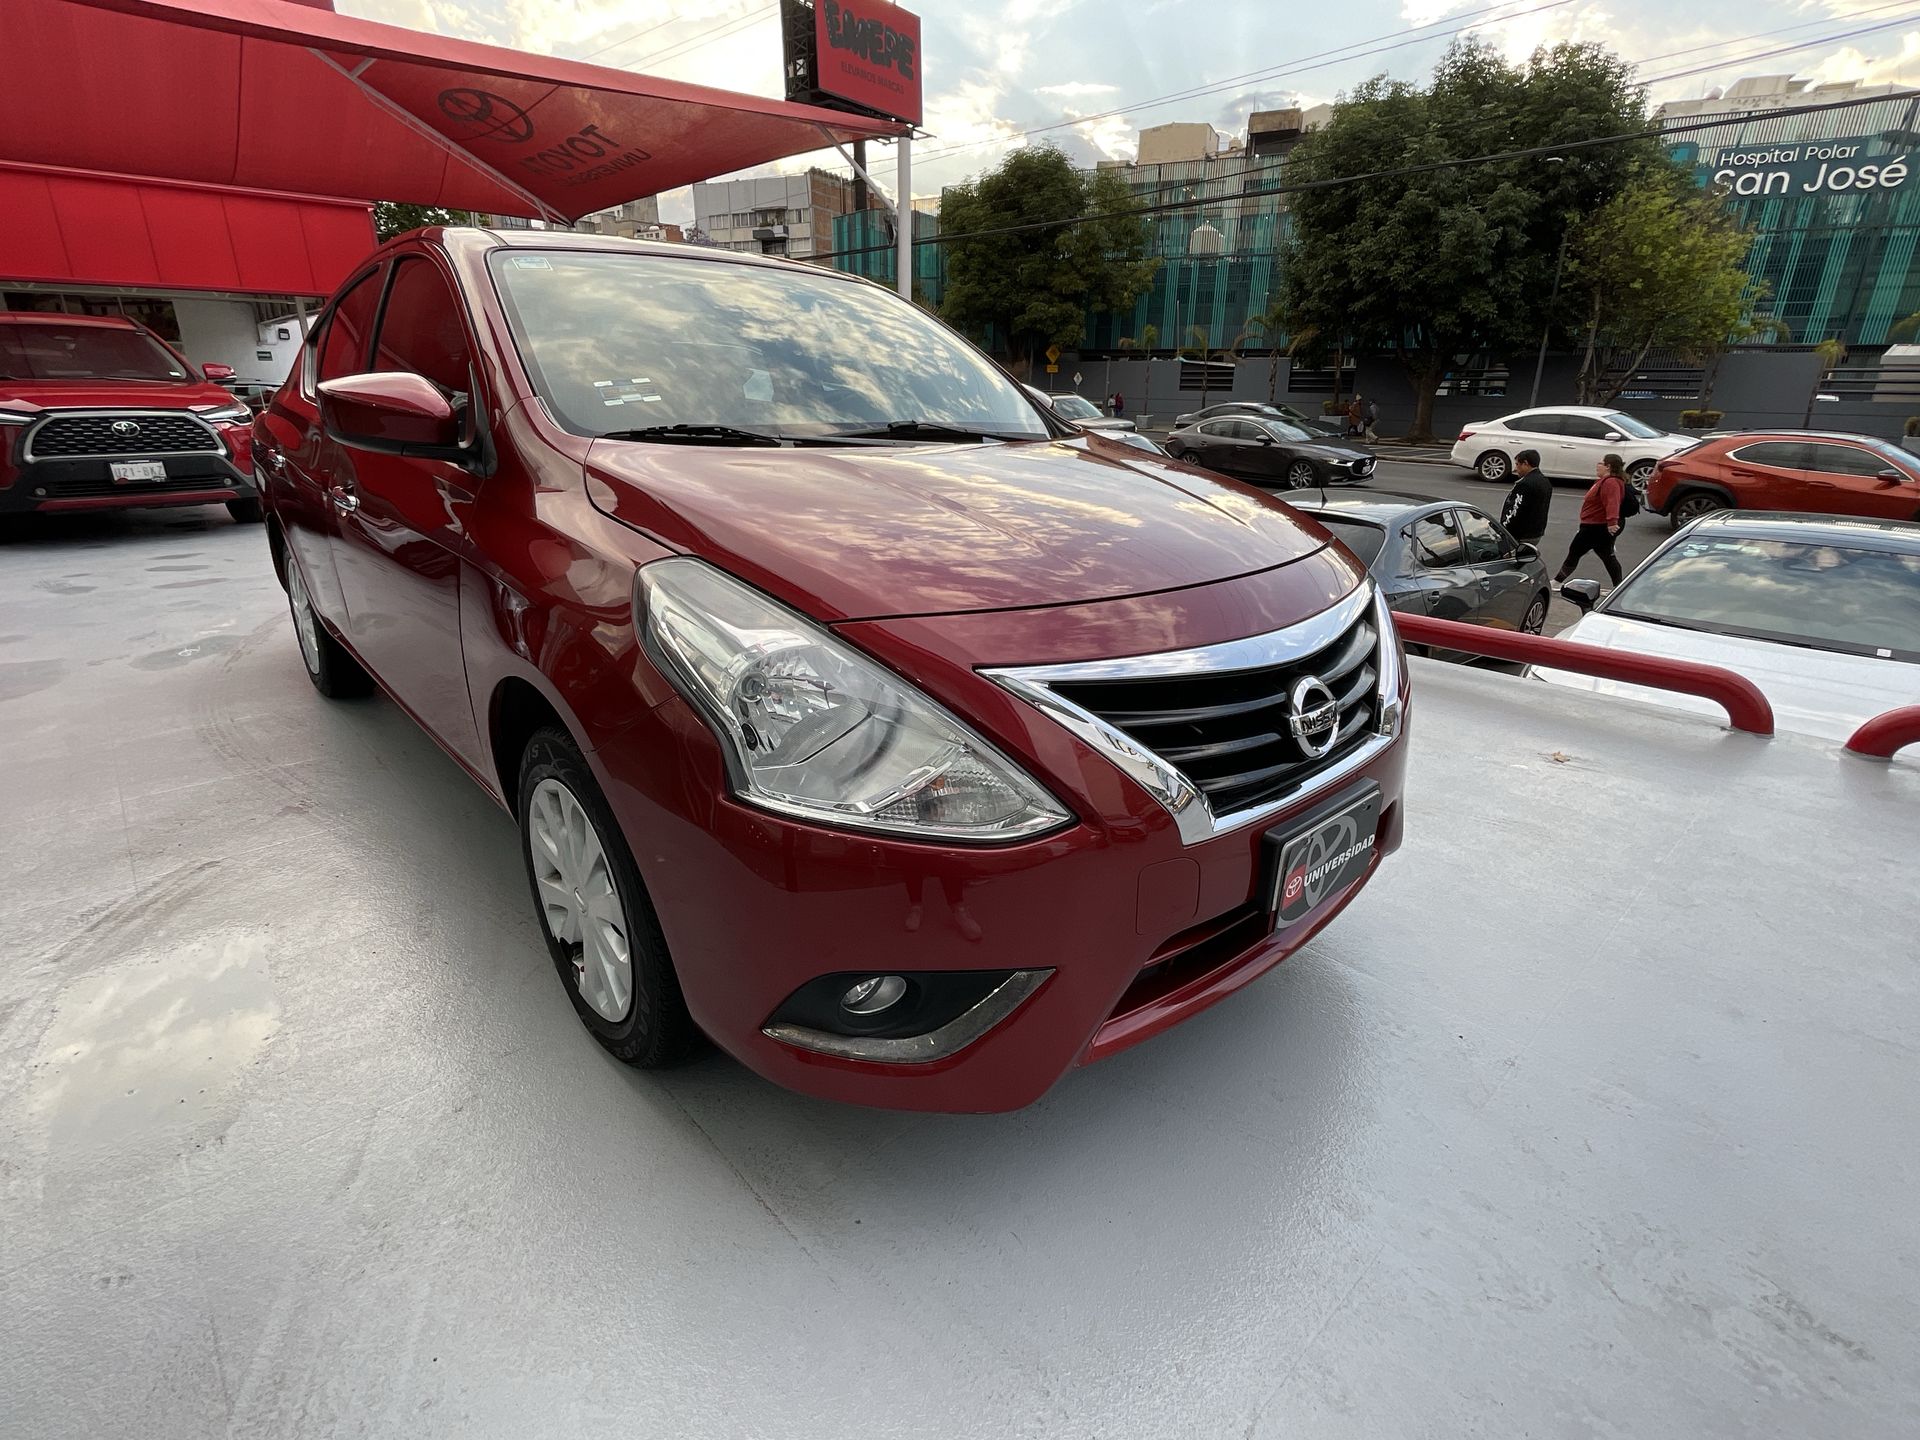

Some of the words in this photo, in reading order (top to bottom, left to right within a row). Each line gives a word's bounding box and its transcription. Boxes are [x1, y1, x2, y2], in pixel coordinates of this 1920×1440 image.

[1712, 169, 1790, 196] San
[1803, 155, 1908, 192] José
[1720, 147, 1800, 168] Hospital
[1805, 144, 1861, 160] Polar
[1304, 834, 1375, 887] UNIVERSIDAD
